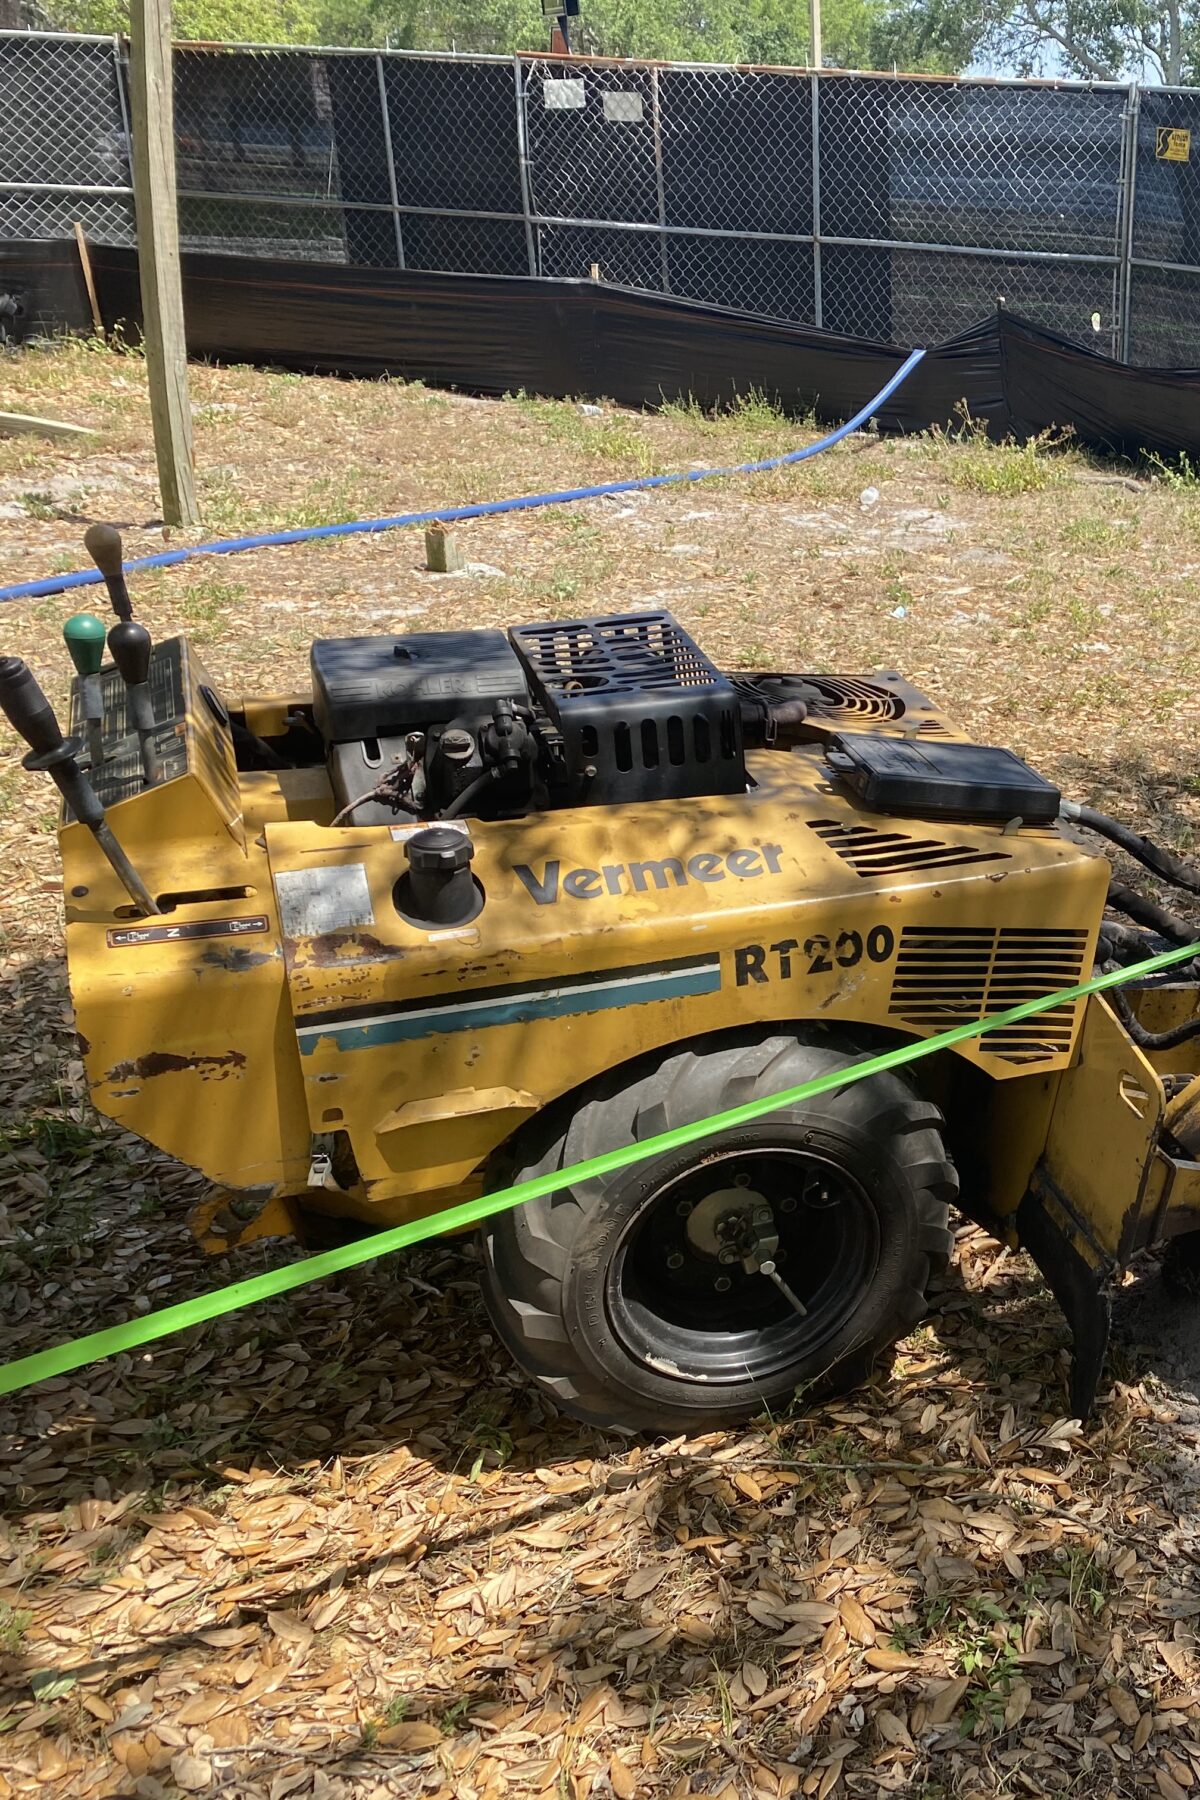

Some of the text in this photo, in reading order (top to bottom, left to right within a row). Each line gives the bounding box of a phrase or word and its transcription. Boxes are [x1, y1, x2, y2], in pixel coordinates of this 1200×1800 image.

[376, 678, 471, 698] KOHLER
[512, 843, 783, 905] Vermeer
[735, 925, 894, 986] RT200
